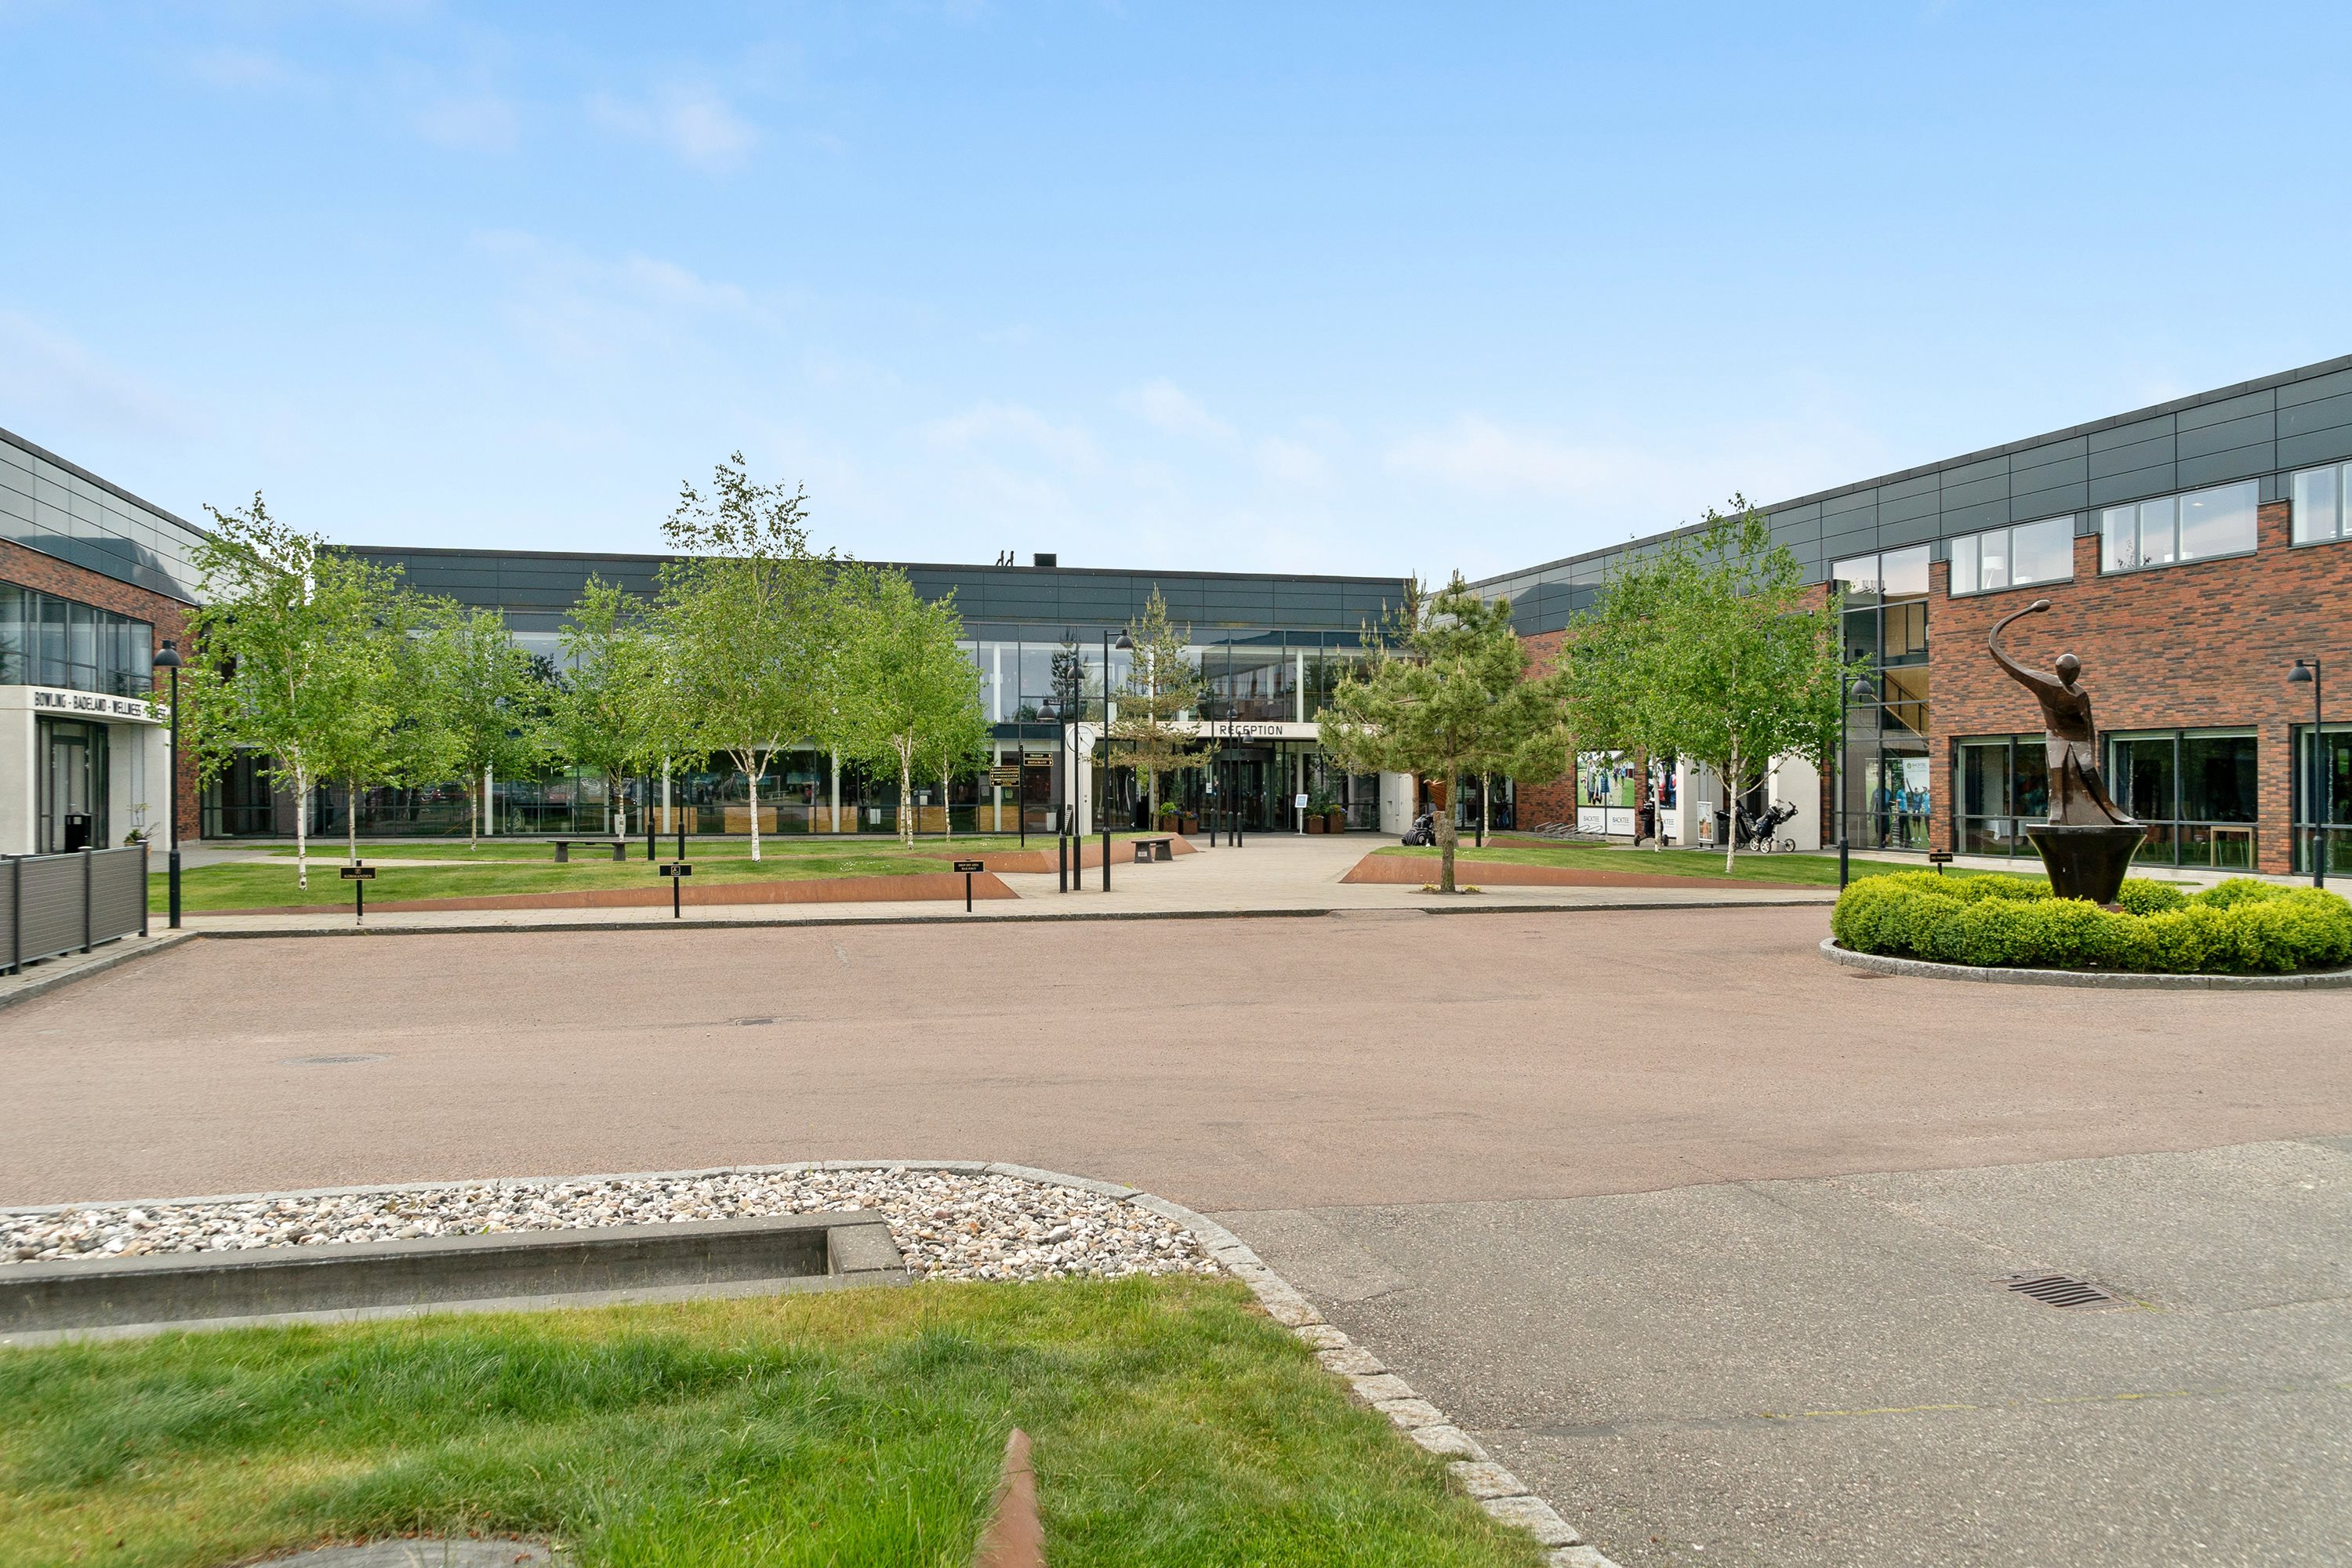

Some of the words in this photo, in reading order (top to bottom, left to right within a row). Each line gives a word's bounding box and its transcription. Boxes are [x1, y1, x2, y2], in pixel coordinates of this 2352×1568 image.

[34, 691, 66, 708] BOWLING
[74, 695, 107, 711] BADELAND
[112, 700, 141, 717] WELLNESS
[1220, 725, 1283, 735] RECEPTION
